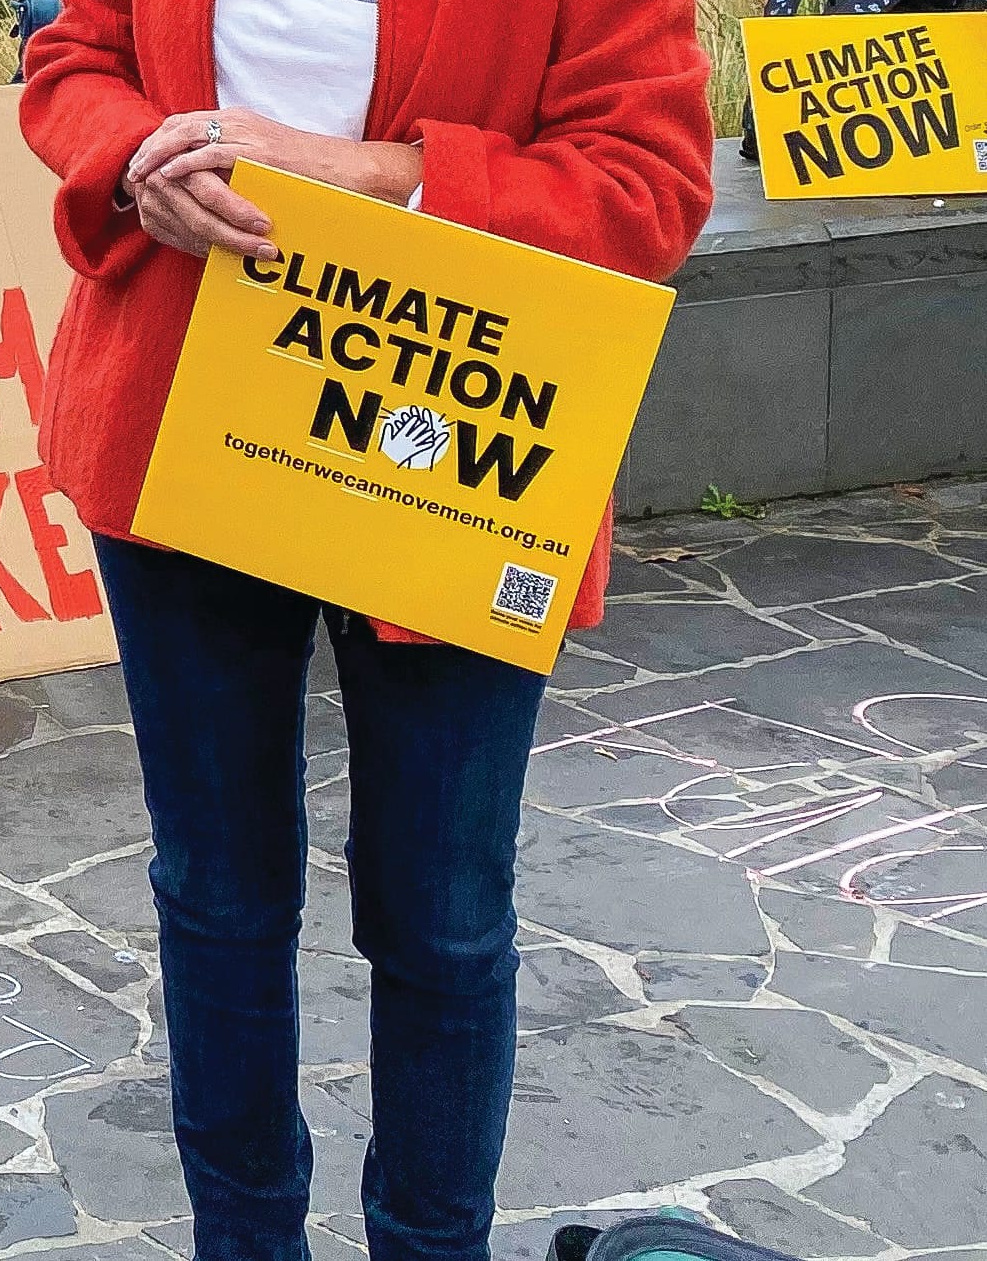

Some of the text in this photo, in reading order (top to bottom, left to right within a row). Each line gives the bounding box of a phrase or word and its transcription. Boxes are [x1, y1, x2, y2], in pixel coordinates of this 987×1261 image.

[760, 25, 936, 94] CLIMATE
[800, 58, 951, 125] ACTION
[782, 92, 961, 186] NOW
[242, 248, 510, 355] CLIMATE
[272, 305, 559, 430] ACTION
[223, 431, 571, 557] togetherwecanmovement.org.au
